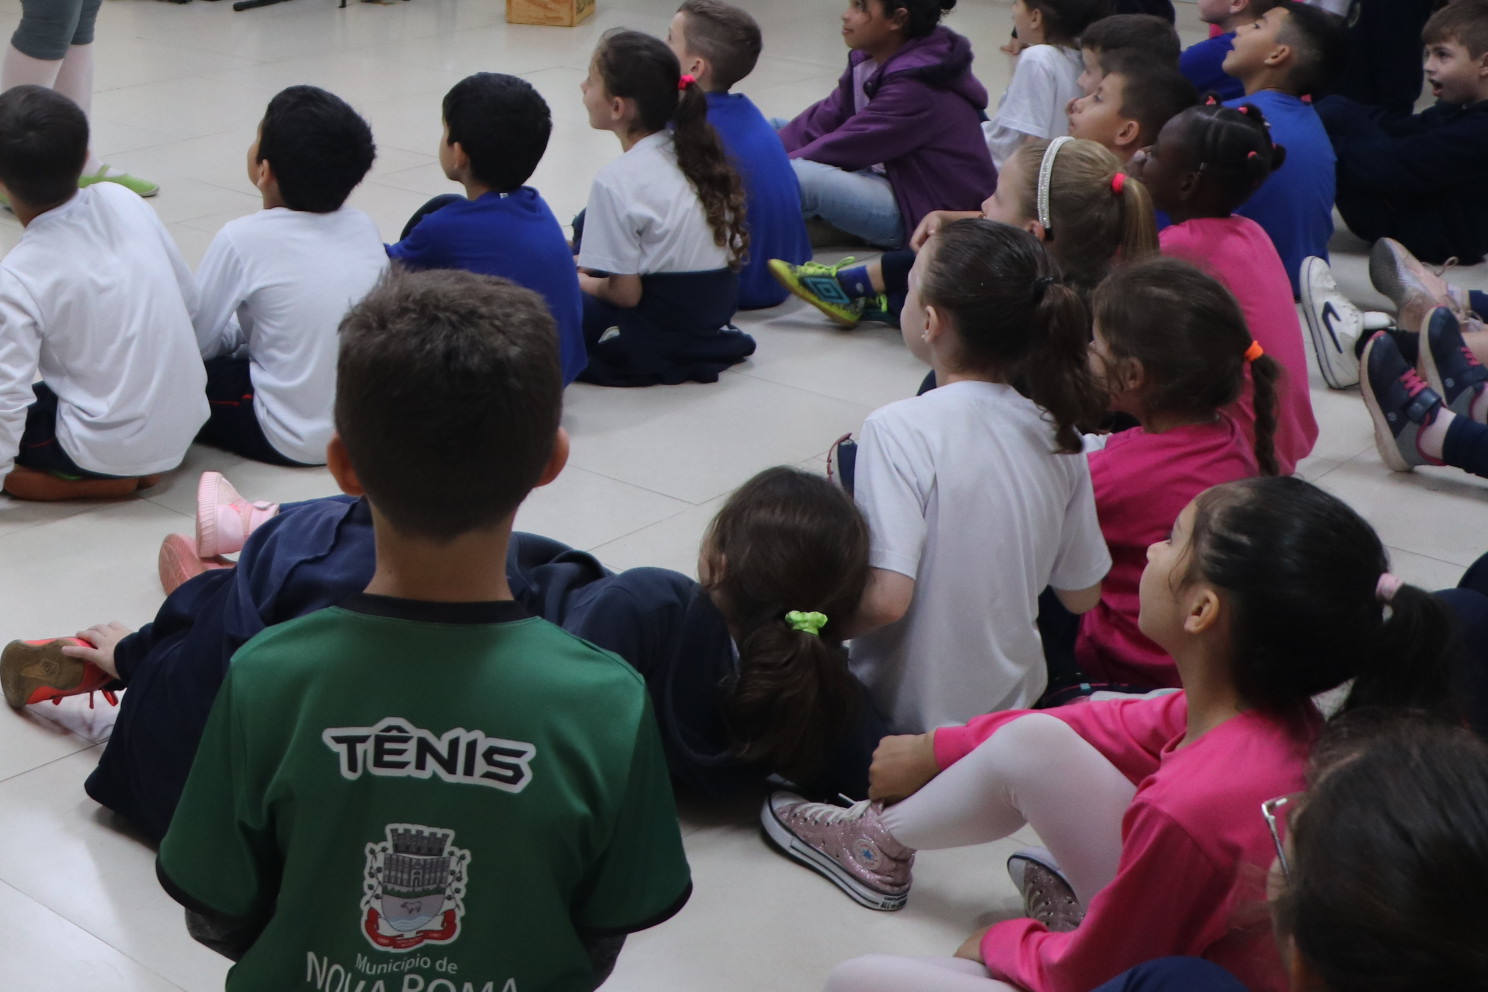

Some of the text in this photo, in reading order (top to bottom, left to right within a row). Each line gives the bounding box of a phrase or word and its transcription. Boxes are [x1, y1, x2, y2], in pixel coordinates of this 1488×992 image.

[328, 722, 530, 787] TÊNIS
[355, 952, 458, 976] Município de
